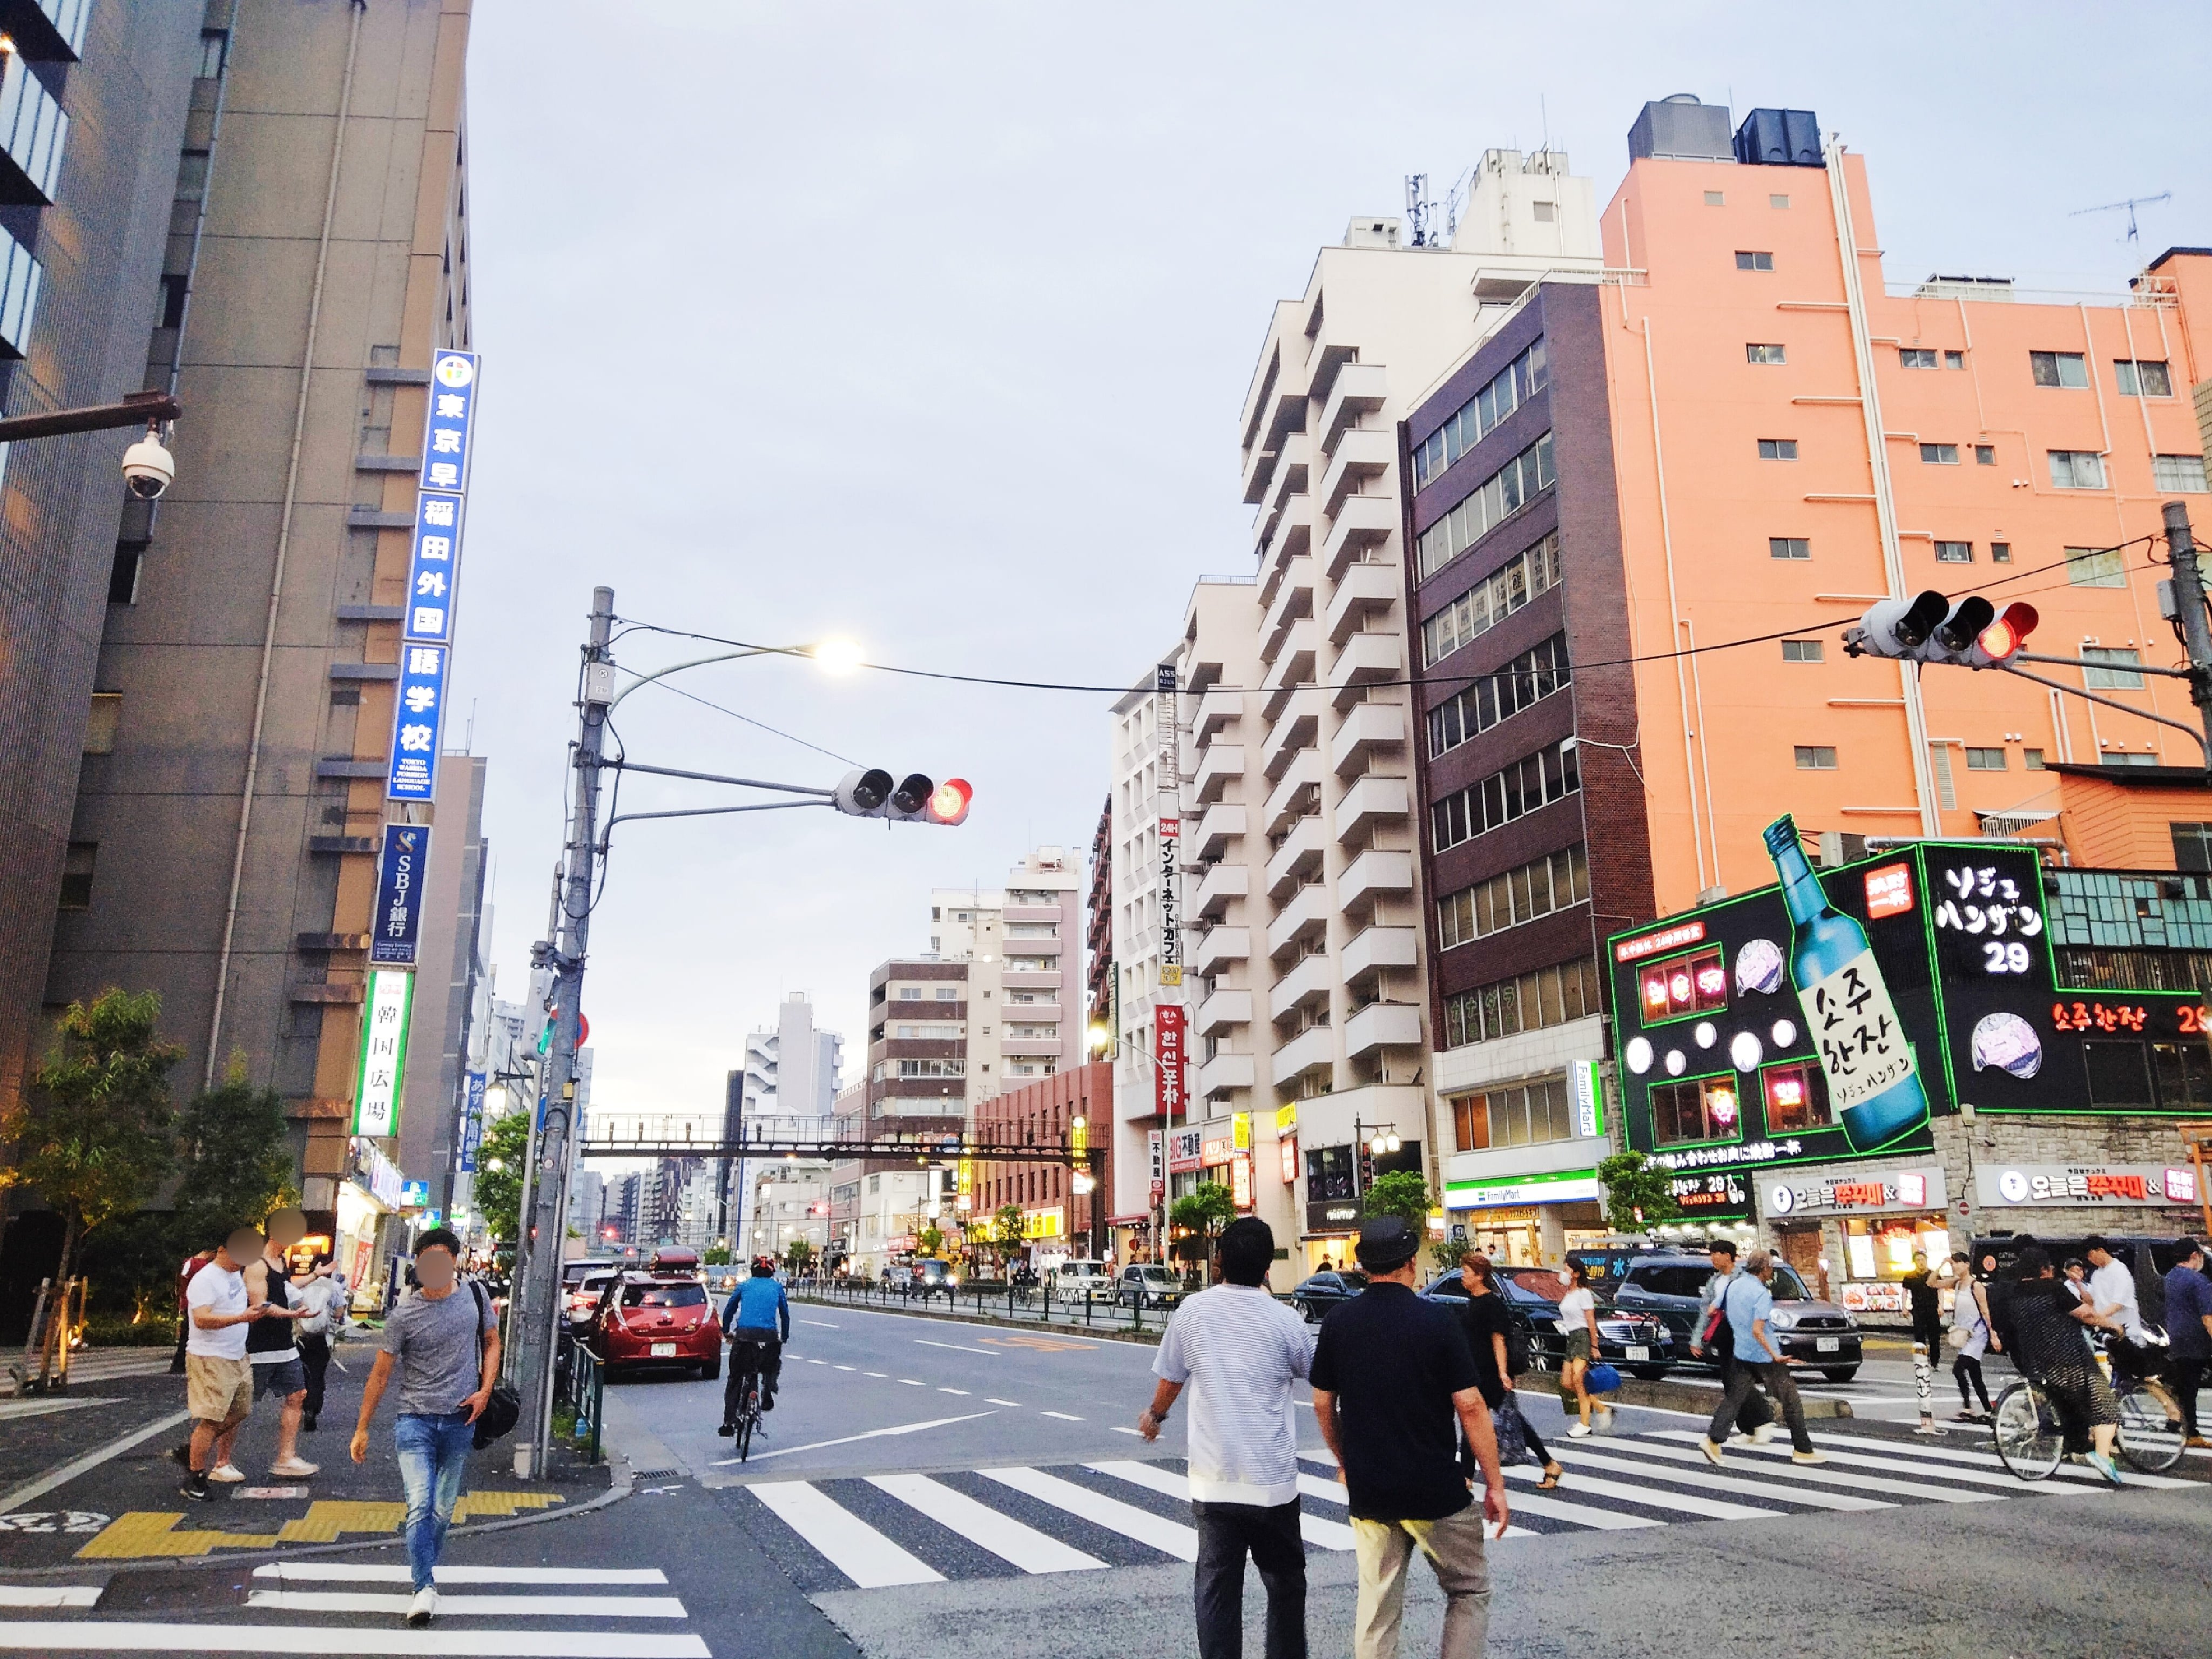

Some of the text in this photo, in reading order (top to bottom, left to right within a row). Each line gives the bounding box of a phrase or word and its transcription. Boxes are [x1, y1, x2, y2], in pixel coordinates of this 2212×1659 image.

[1161, 823, 1178, 833] 24H
[387, 855, 411, 938] SBJ銀行
[1945, 866, 2021, 900] ソジュ
[1162, 838, 1175, 965] インターネットカフェ
[1935, 900, 2042, 936] ハンザン
[1981, 941, 2031, 974] 29
[1578, 1065, 1593, 1132] FamilyMart
[1487, 1189, 1520, 1201] FamilyMart
